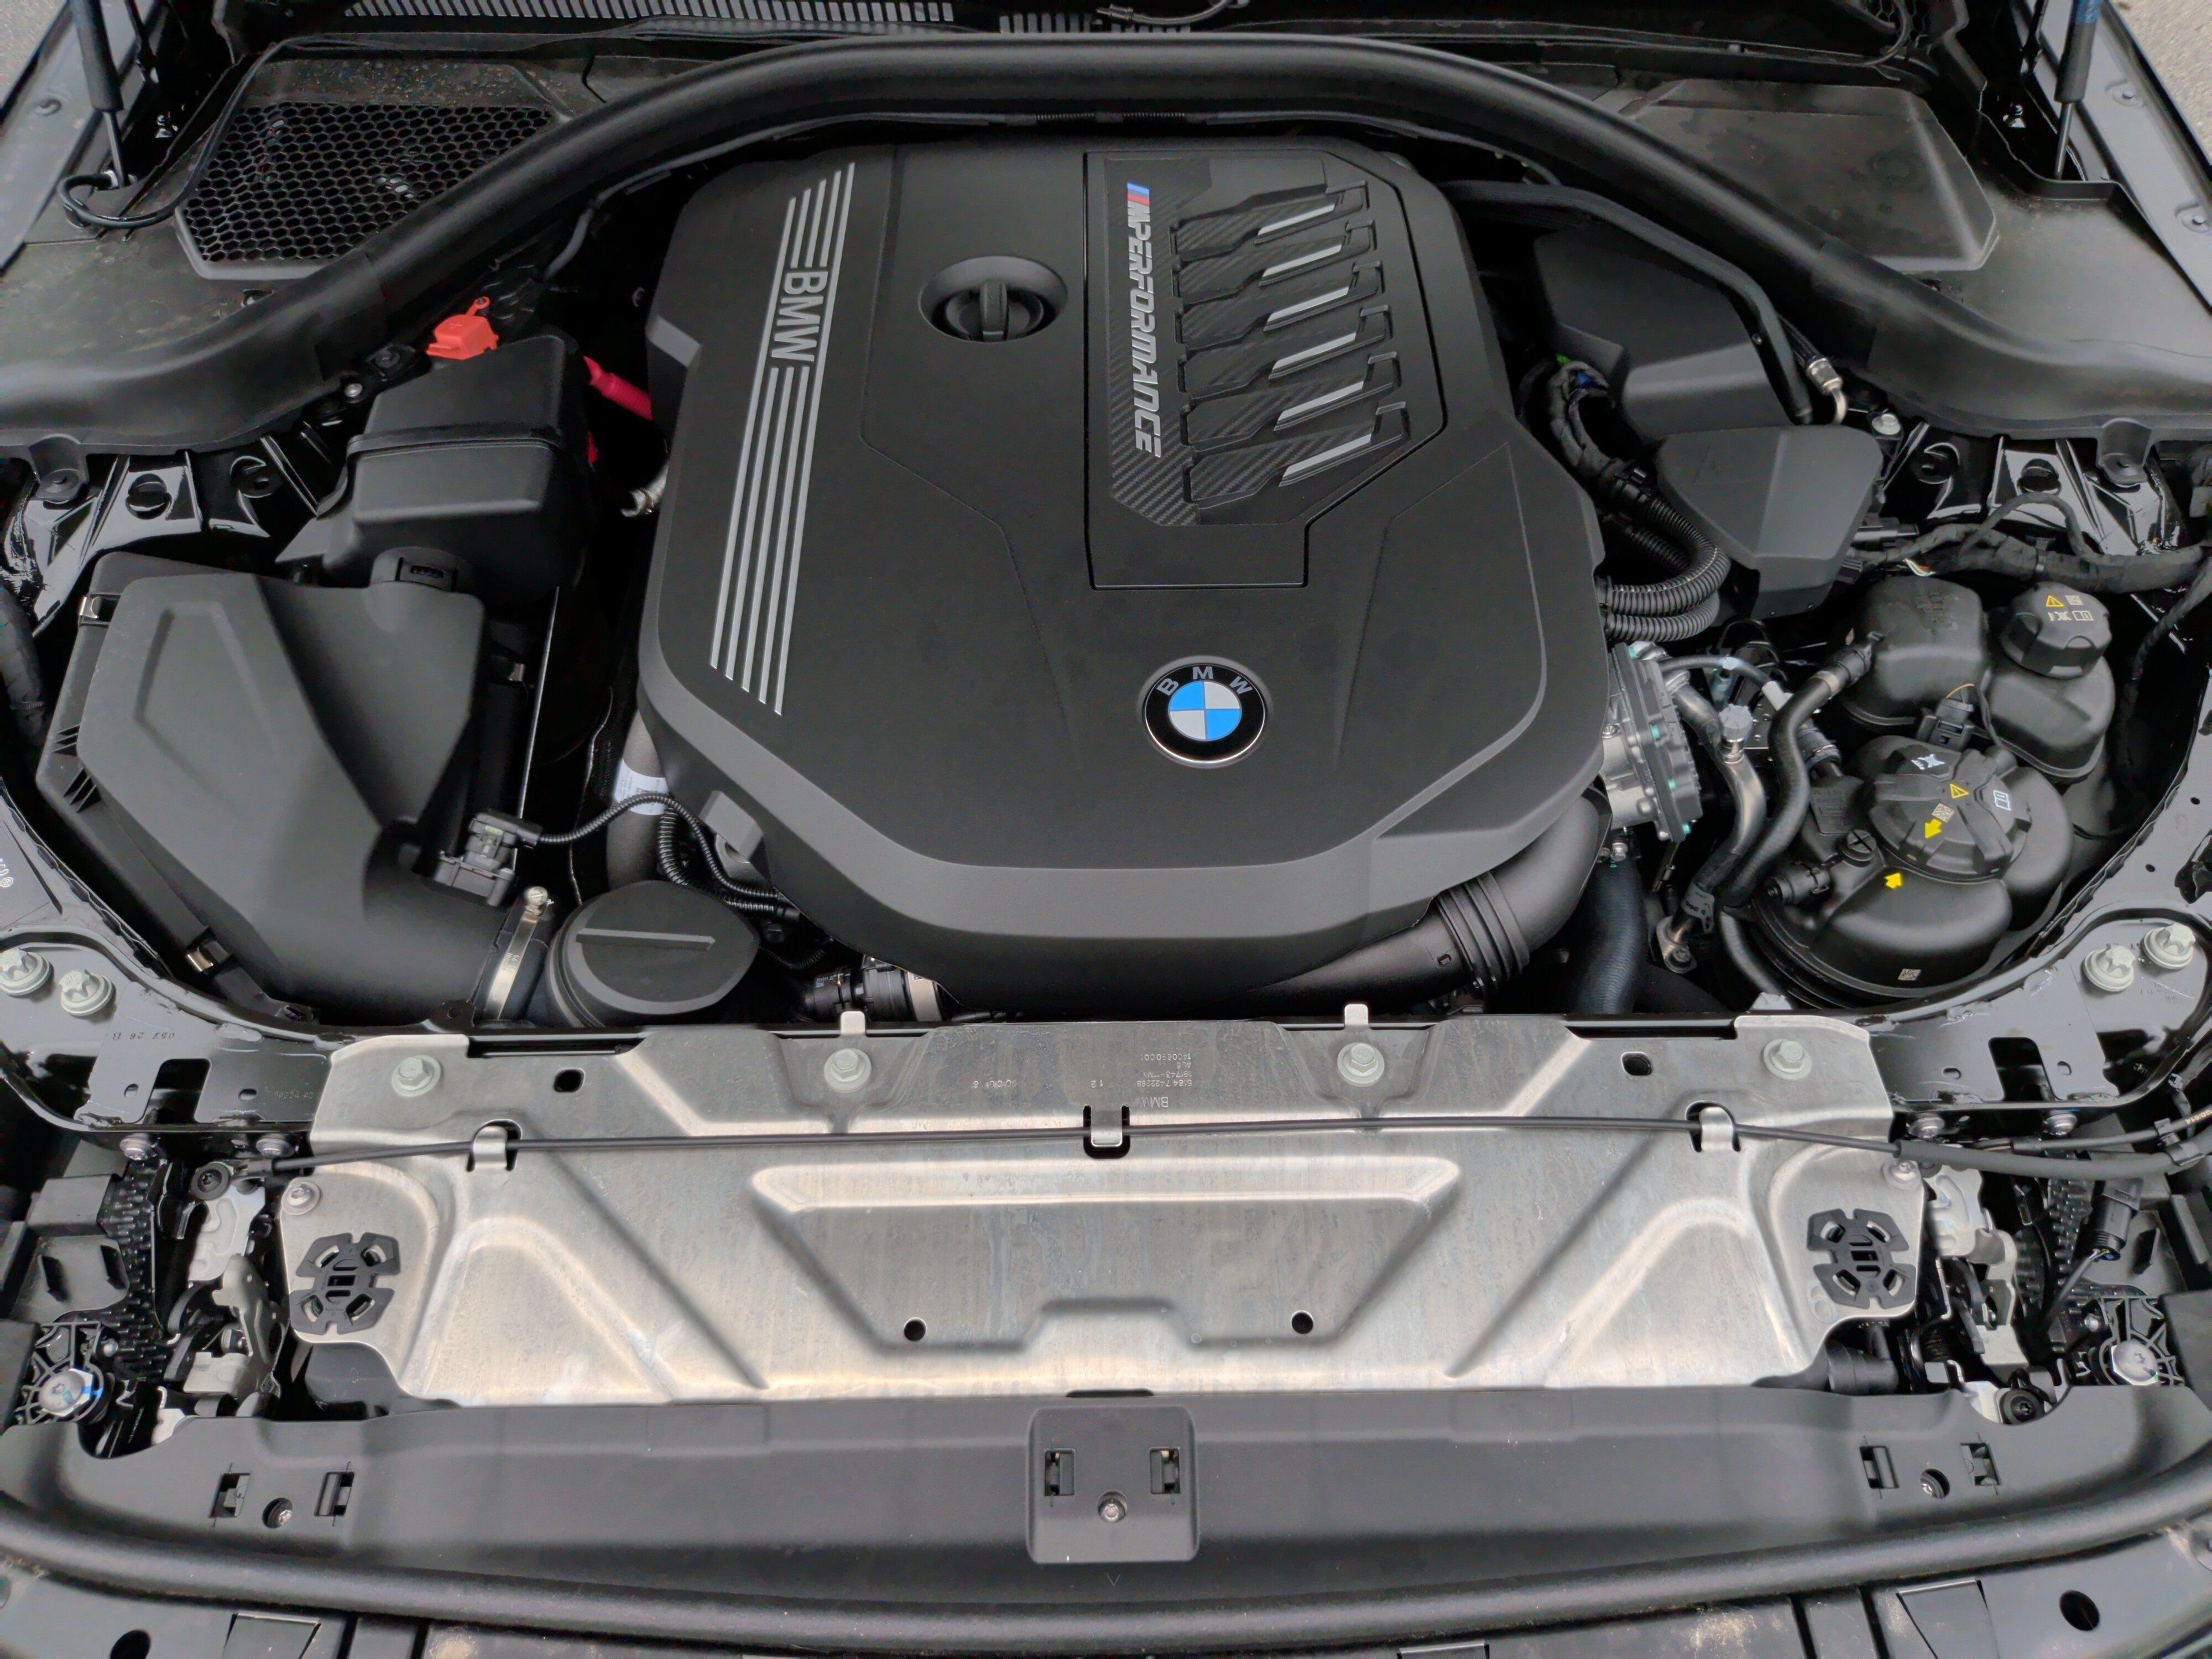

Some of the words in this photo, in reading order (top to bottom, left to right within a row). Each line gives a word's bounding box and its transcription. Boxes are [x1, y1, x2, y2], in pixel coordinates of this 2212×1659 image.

[771, 271, 828, 362] BMW
[1157, 666, 1253, 696] BMW
[1140, 1097, 1169, 1108] BMW
